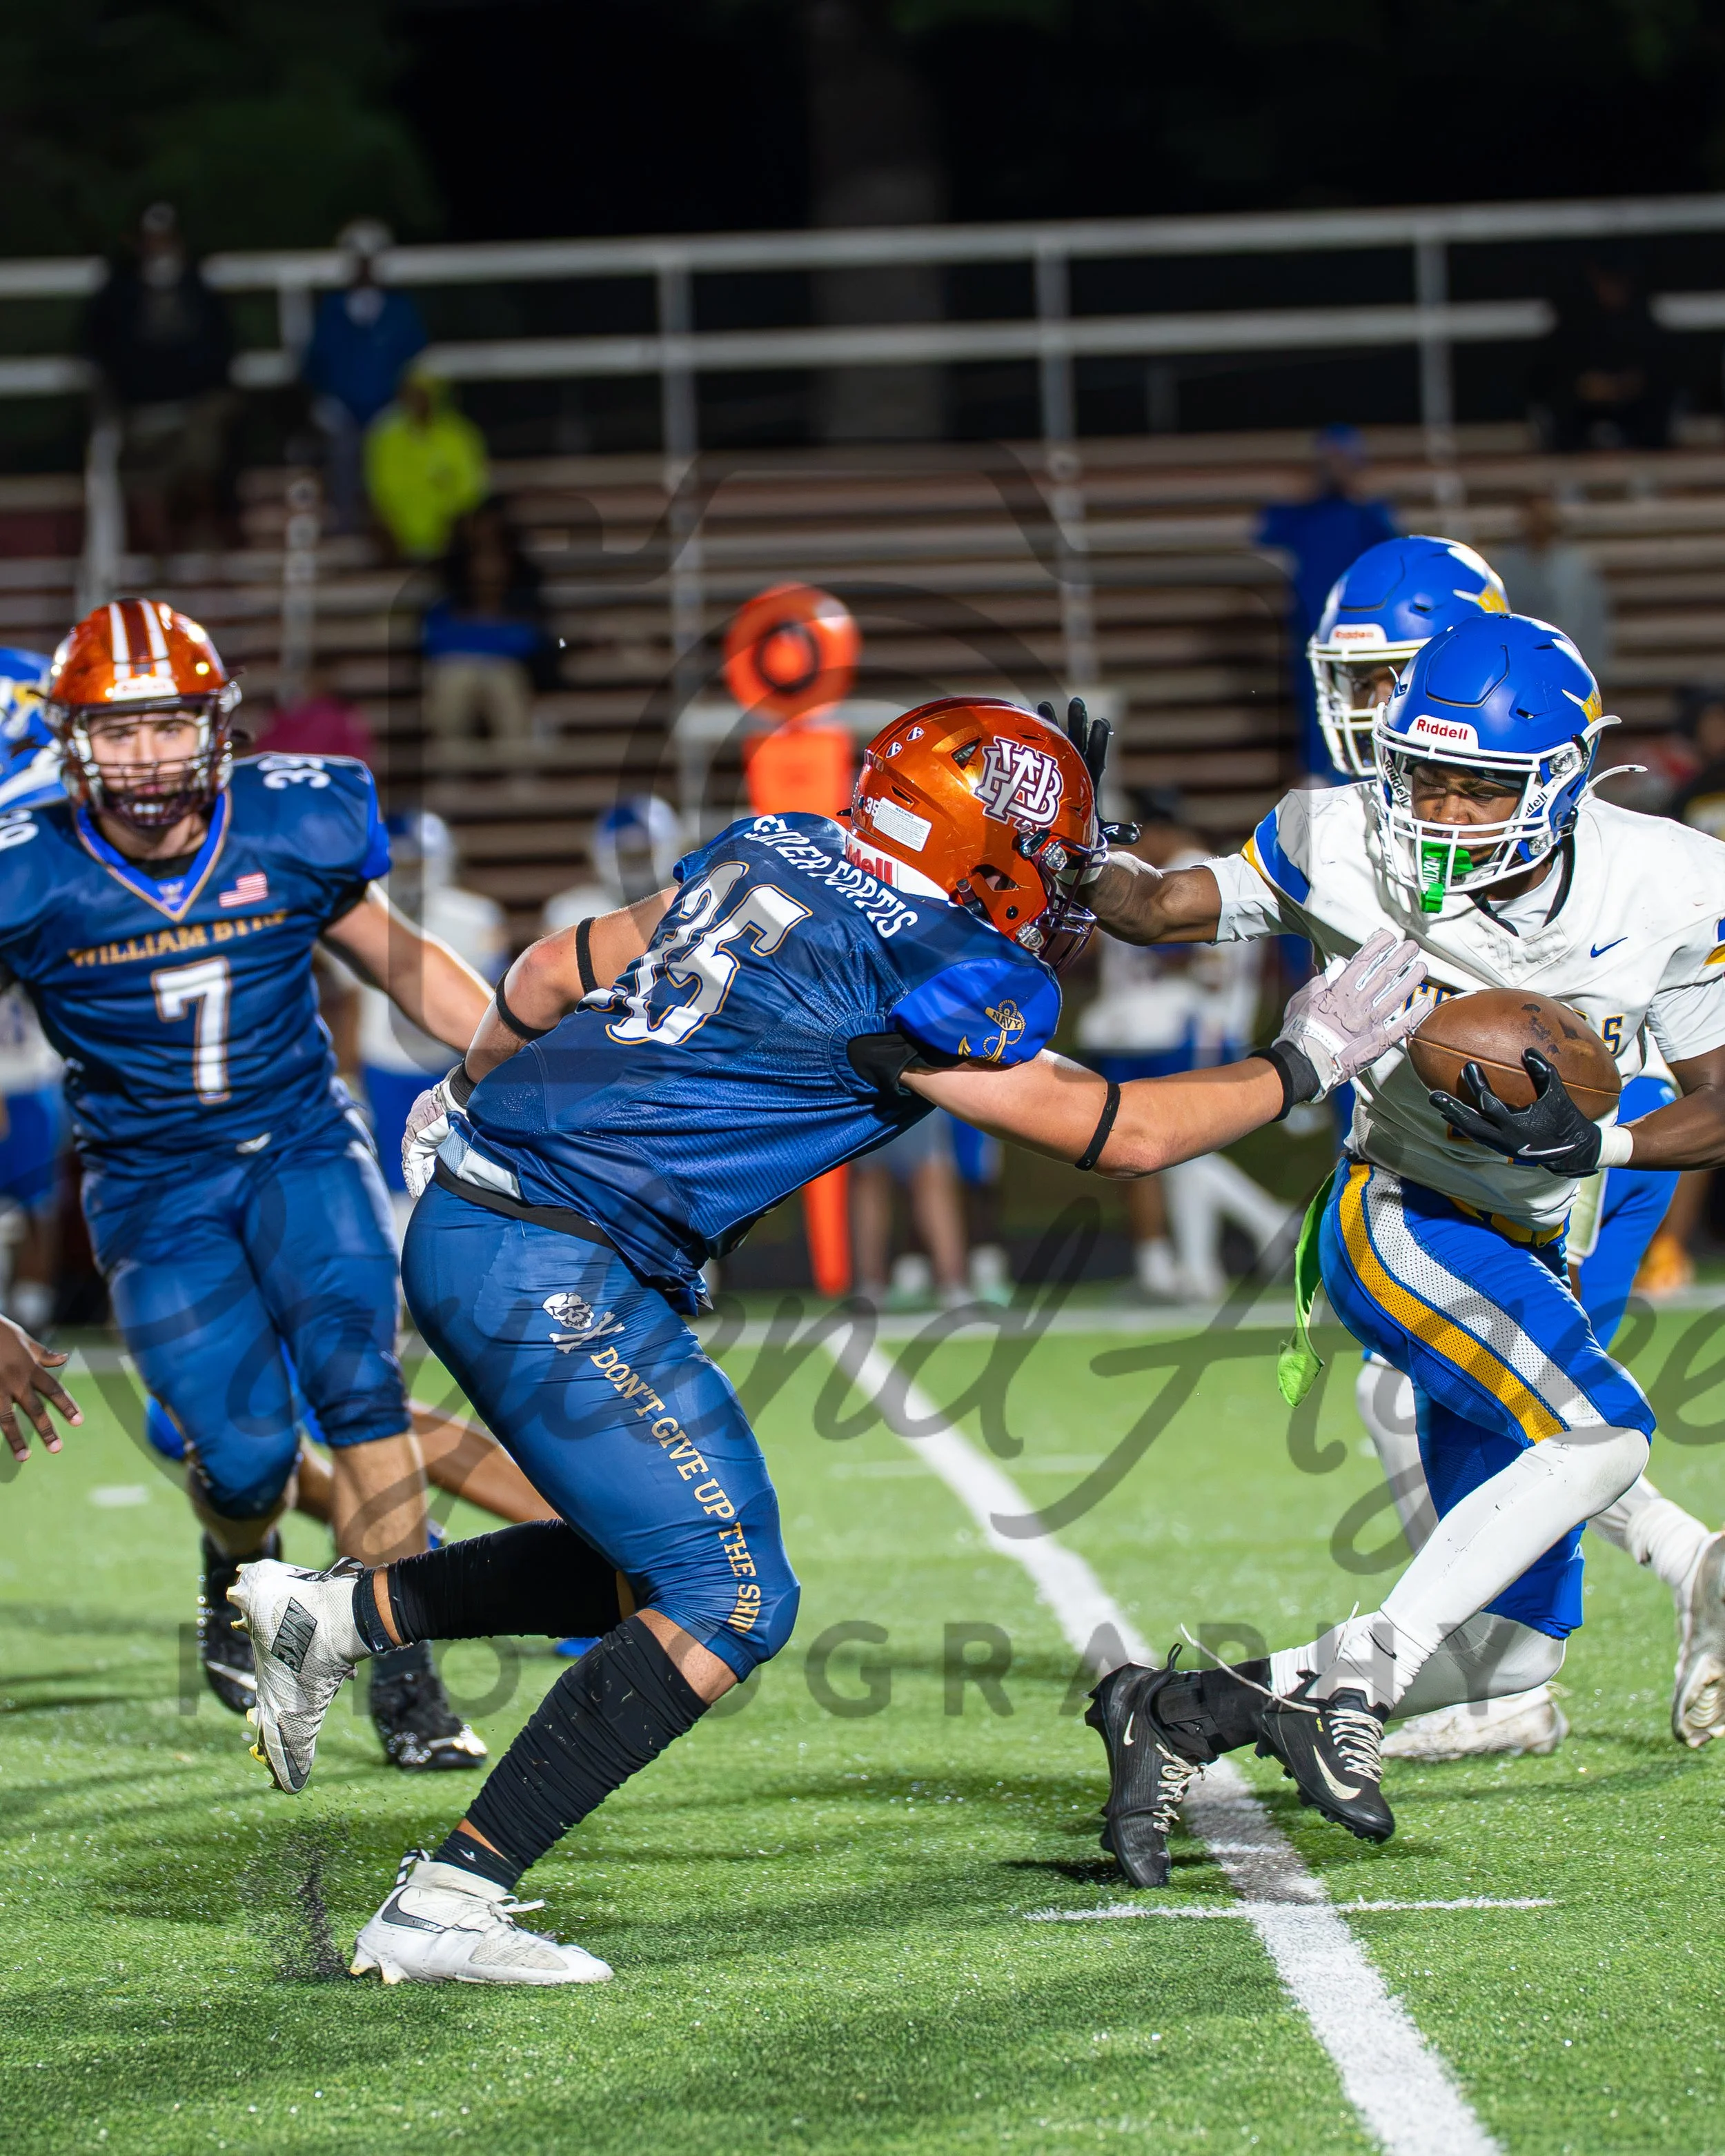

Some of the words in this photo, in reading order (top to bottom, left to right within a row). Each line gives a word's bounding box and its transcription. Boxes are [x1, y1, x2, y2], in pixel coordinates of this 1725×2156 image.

[1417, 719, 1468, 740] Riddell
[1384, 760, 1410, 805] Riddell
[1524, 791, 1548, 817] dell
[865, 796, 881, 817] 35
[807, 860, 918, 938] FORTIS
[67, 923, 208, 967] WILLIAM
[575, 860, 814, 1046] 35
[150, 955, 233, 1106] 7
[992, 1011, 1021, 1029] NAVY
[590, 1347, 666, 1417] DON'T
[651, 1417, 709, 1481] GIVE
[694, 1478, 736, 1521] UP
[718, 1521, 757, 1577] THE
